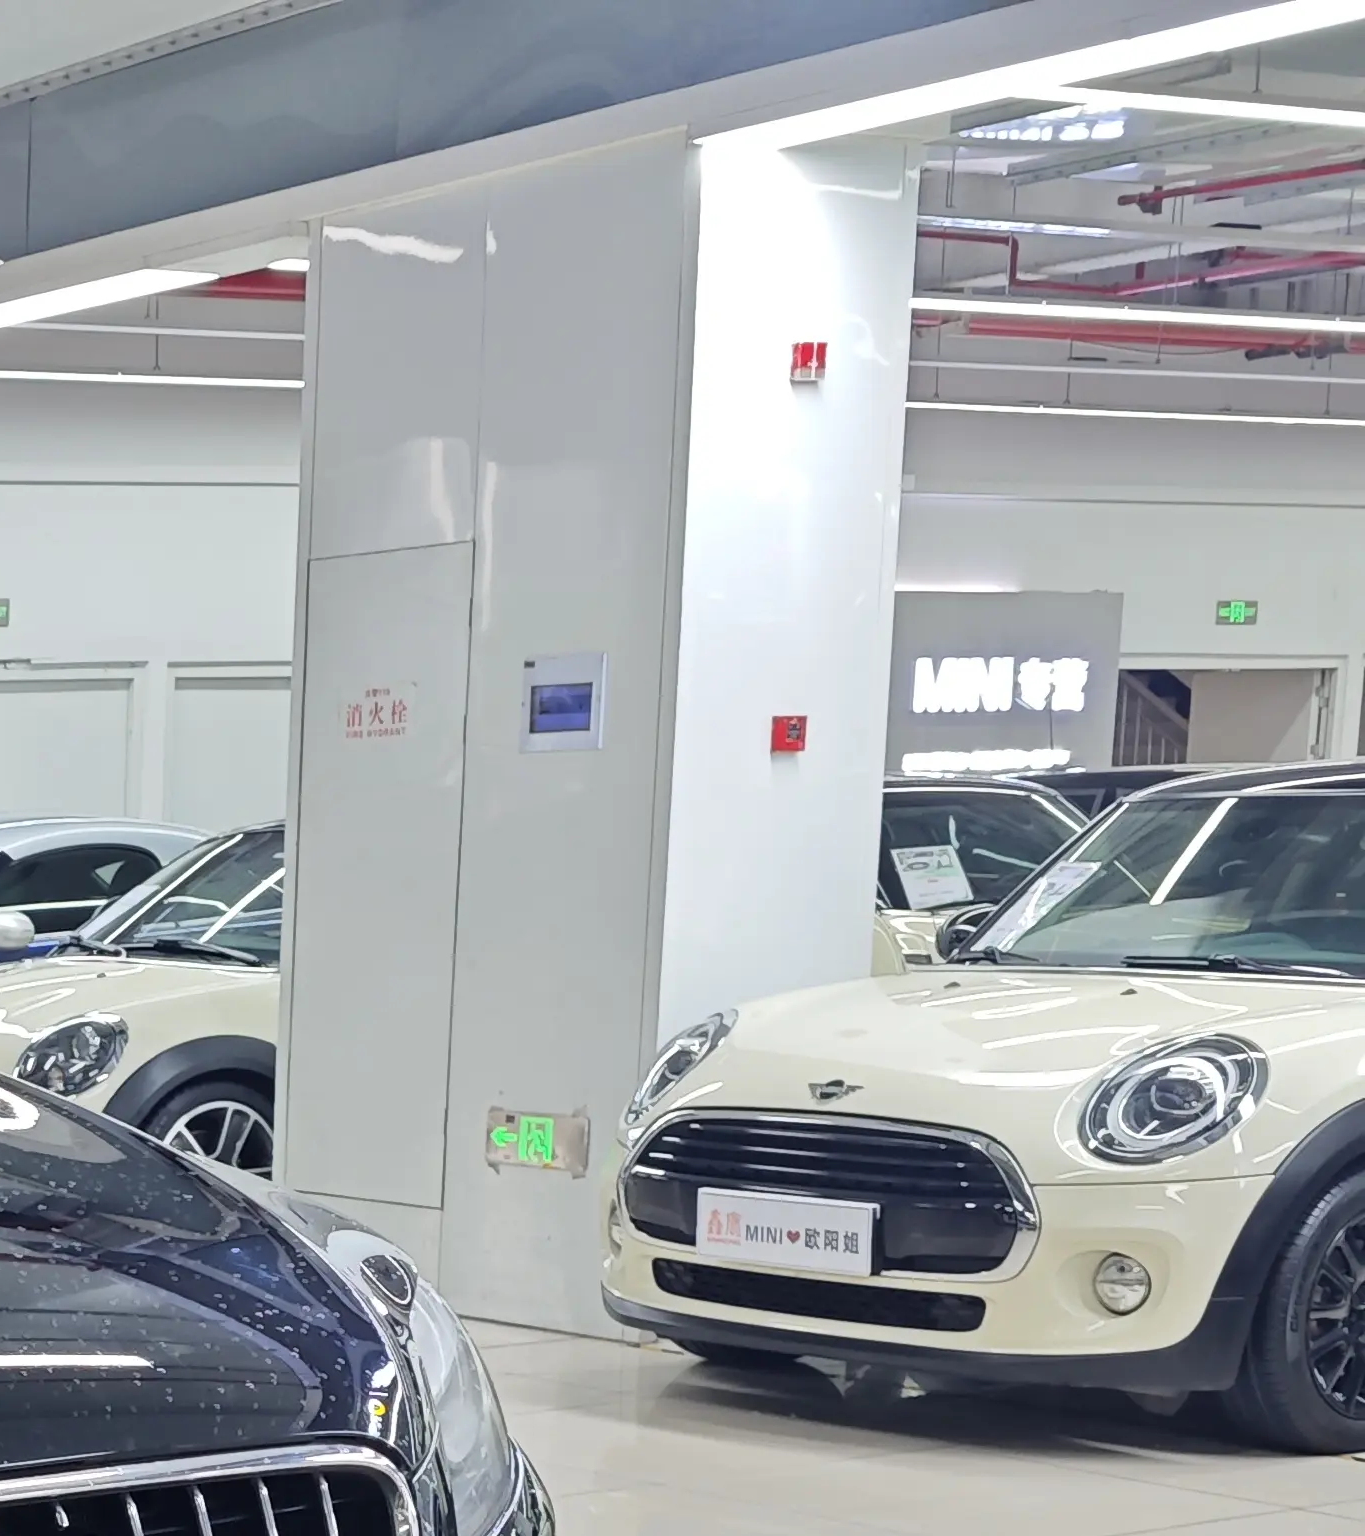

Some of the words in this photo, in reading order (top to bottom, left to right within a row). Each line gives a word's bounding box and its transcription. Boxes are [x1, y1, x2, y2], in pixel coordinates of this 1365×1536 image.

[346, 699, 408, 728] 消火栓
[745, 1224, 783, 1245] MINI
[804, 1227, 859, 1255] 欧阳姐
